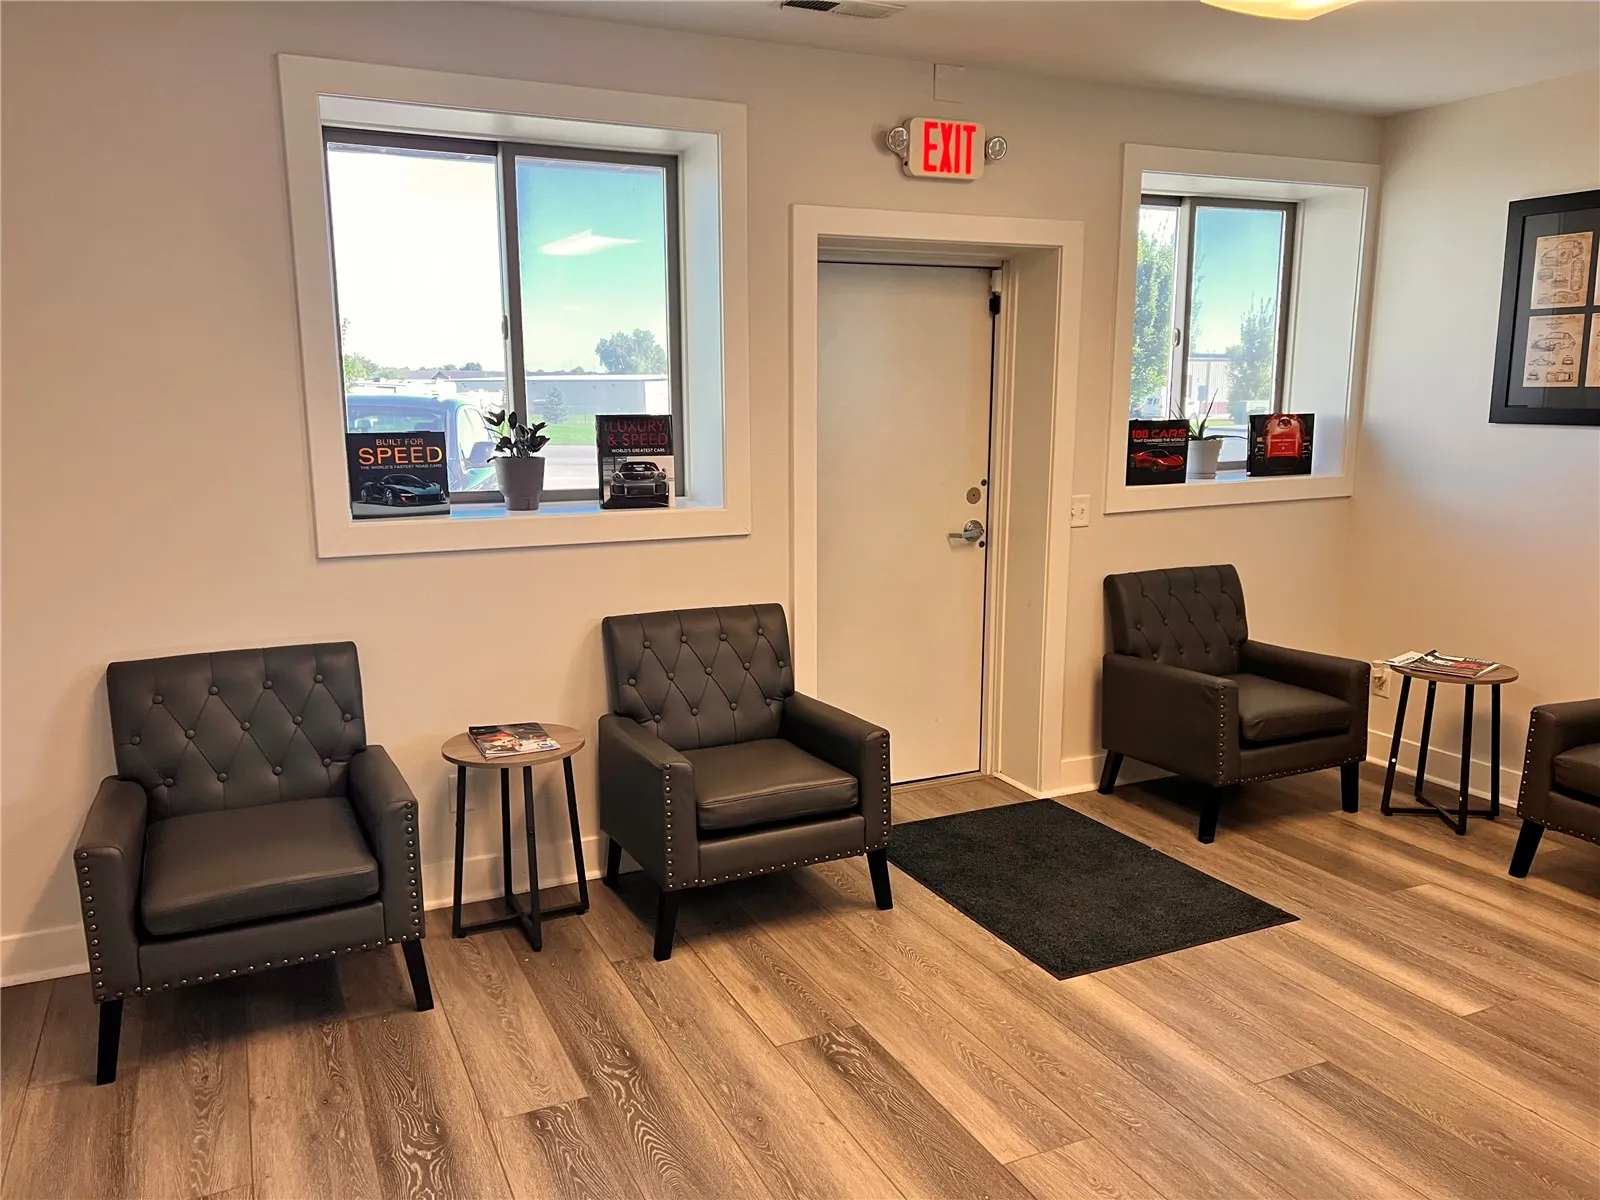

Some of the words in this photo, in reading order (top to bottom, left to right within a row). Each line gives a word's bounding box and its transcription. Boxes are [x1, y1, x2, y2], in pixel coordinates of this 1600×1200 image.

[923, 121, 977, 175] EXIT
[609, 420, 665, 433] LUXURY
[608, 433, 618, 446] &
[622, 433, 669, 446] SPEED
[1131, 429, 1149, 439] 100
[1151, 428, 1187, 438] CARS
[375, 438, 401, 446] BUILT
[404, 437, 424, 445] FOR
[358, 446, 443, 465] SPEED
